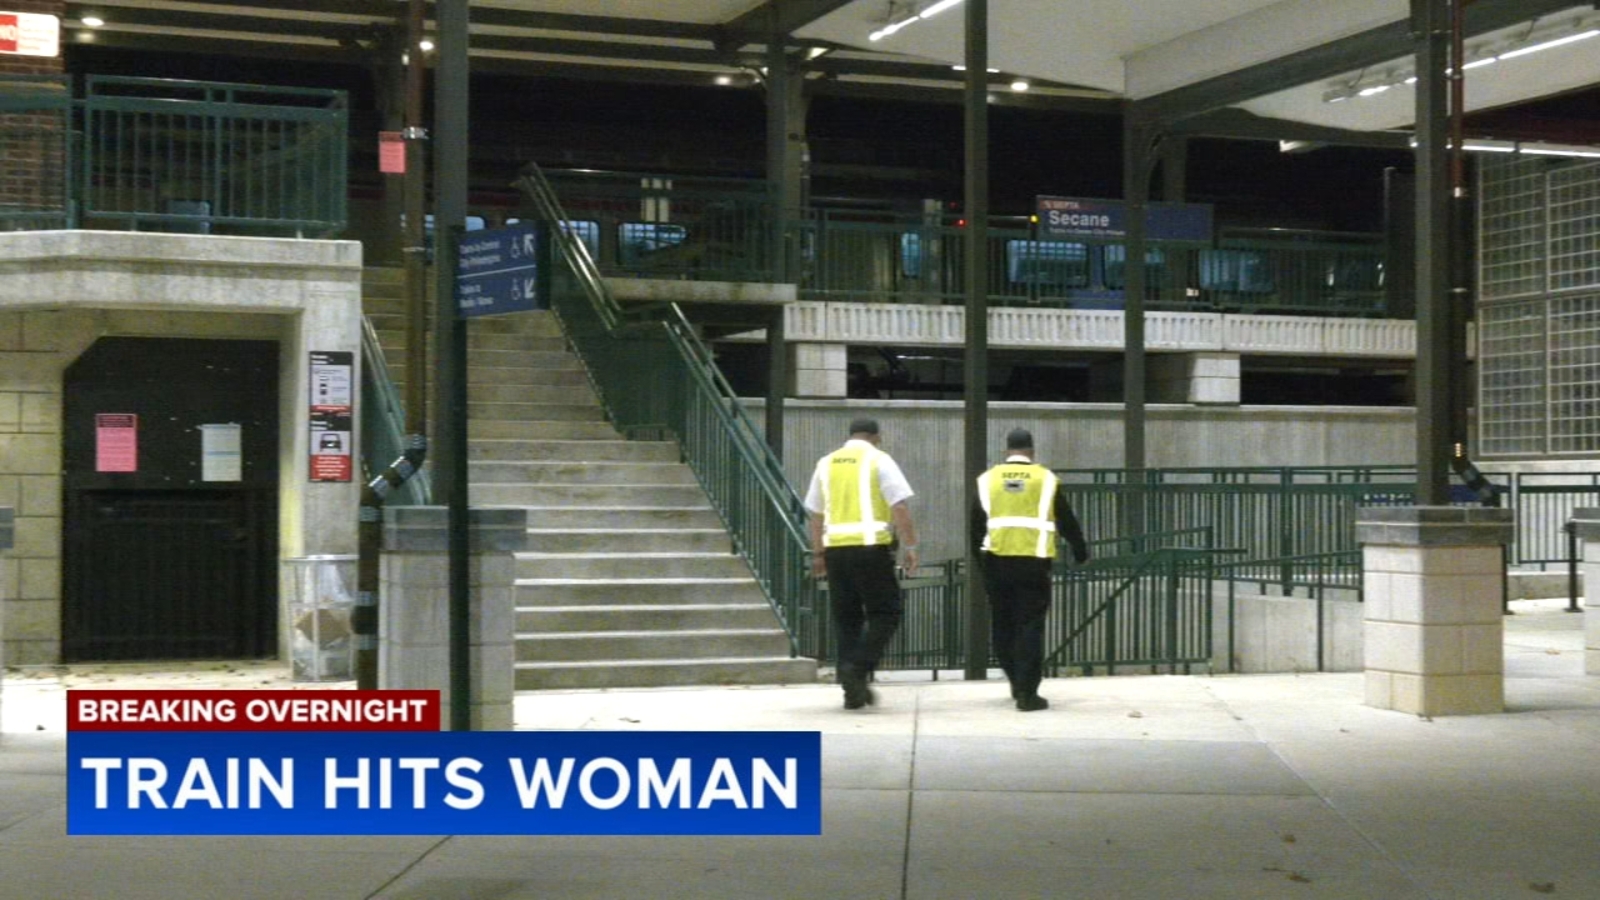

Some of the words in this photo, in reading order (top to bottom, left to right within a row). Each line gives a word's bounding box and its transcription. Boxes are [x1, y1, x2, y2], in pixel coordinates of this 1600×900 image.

[1049, 210, 1110, 227] Secane
[832, 457, 857, 465] SEPTA
[1001, 472, 1031, 480] SEPTA
